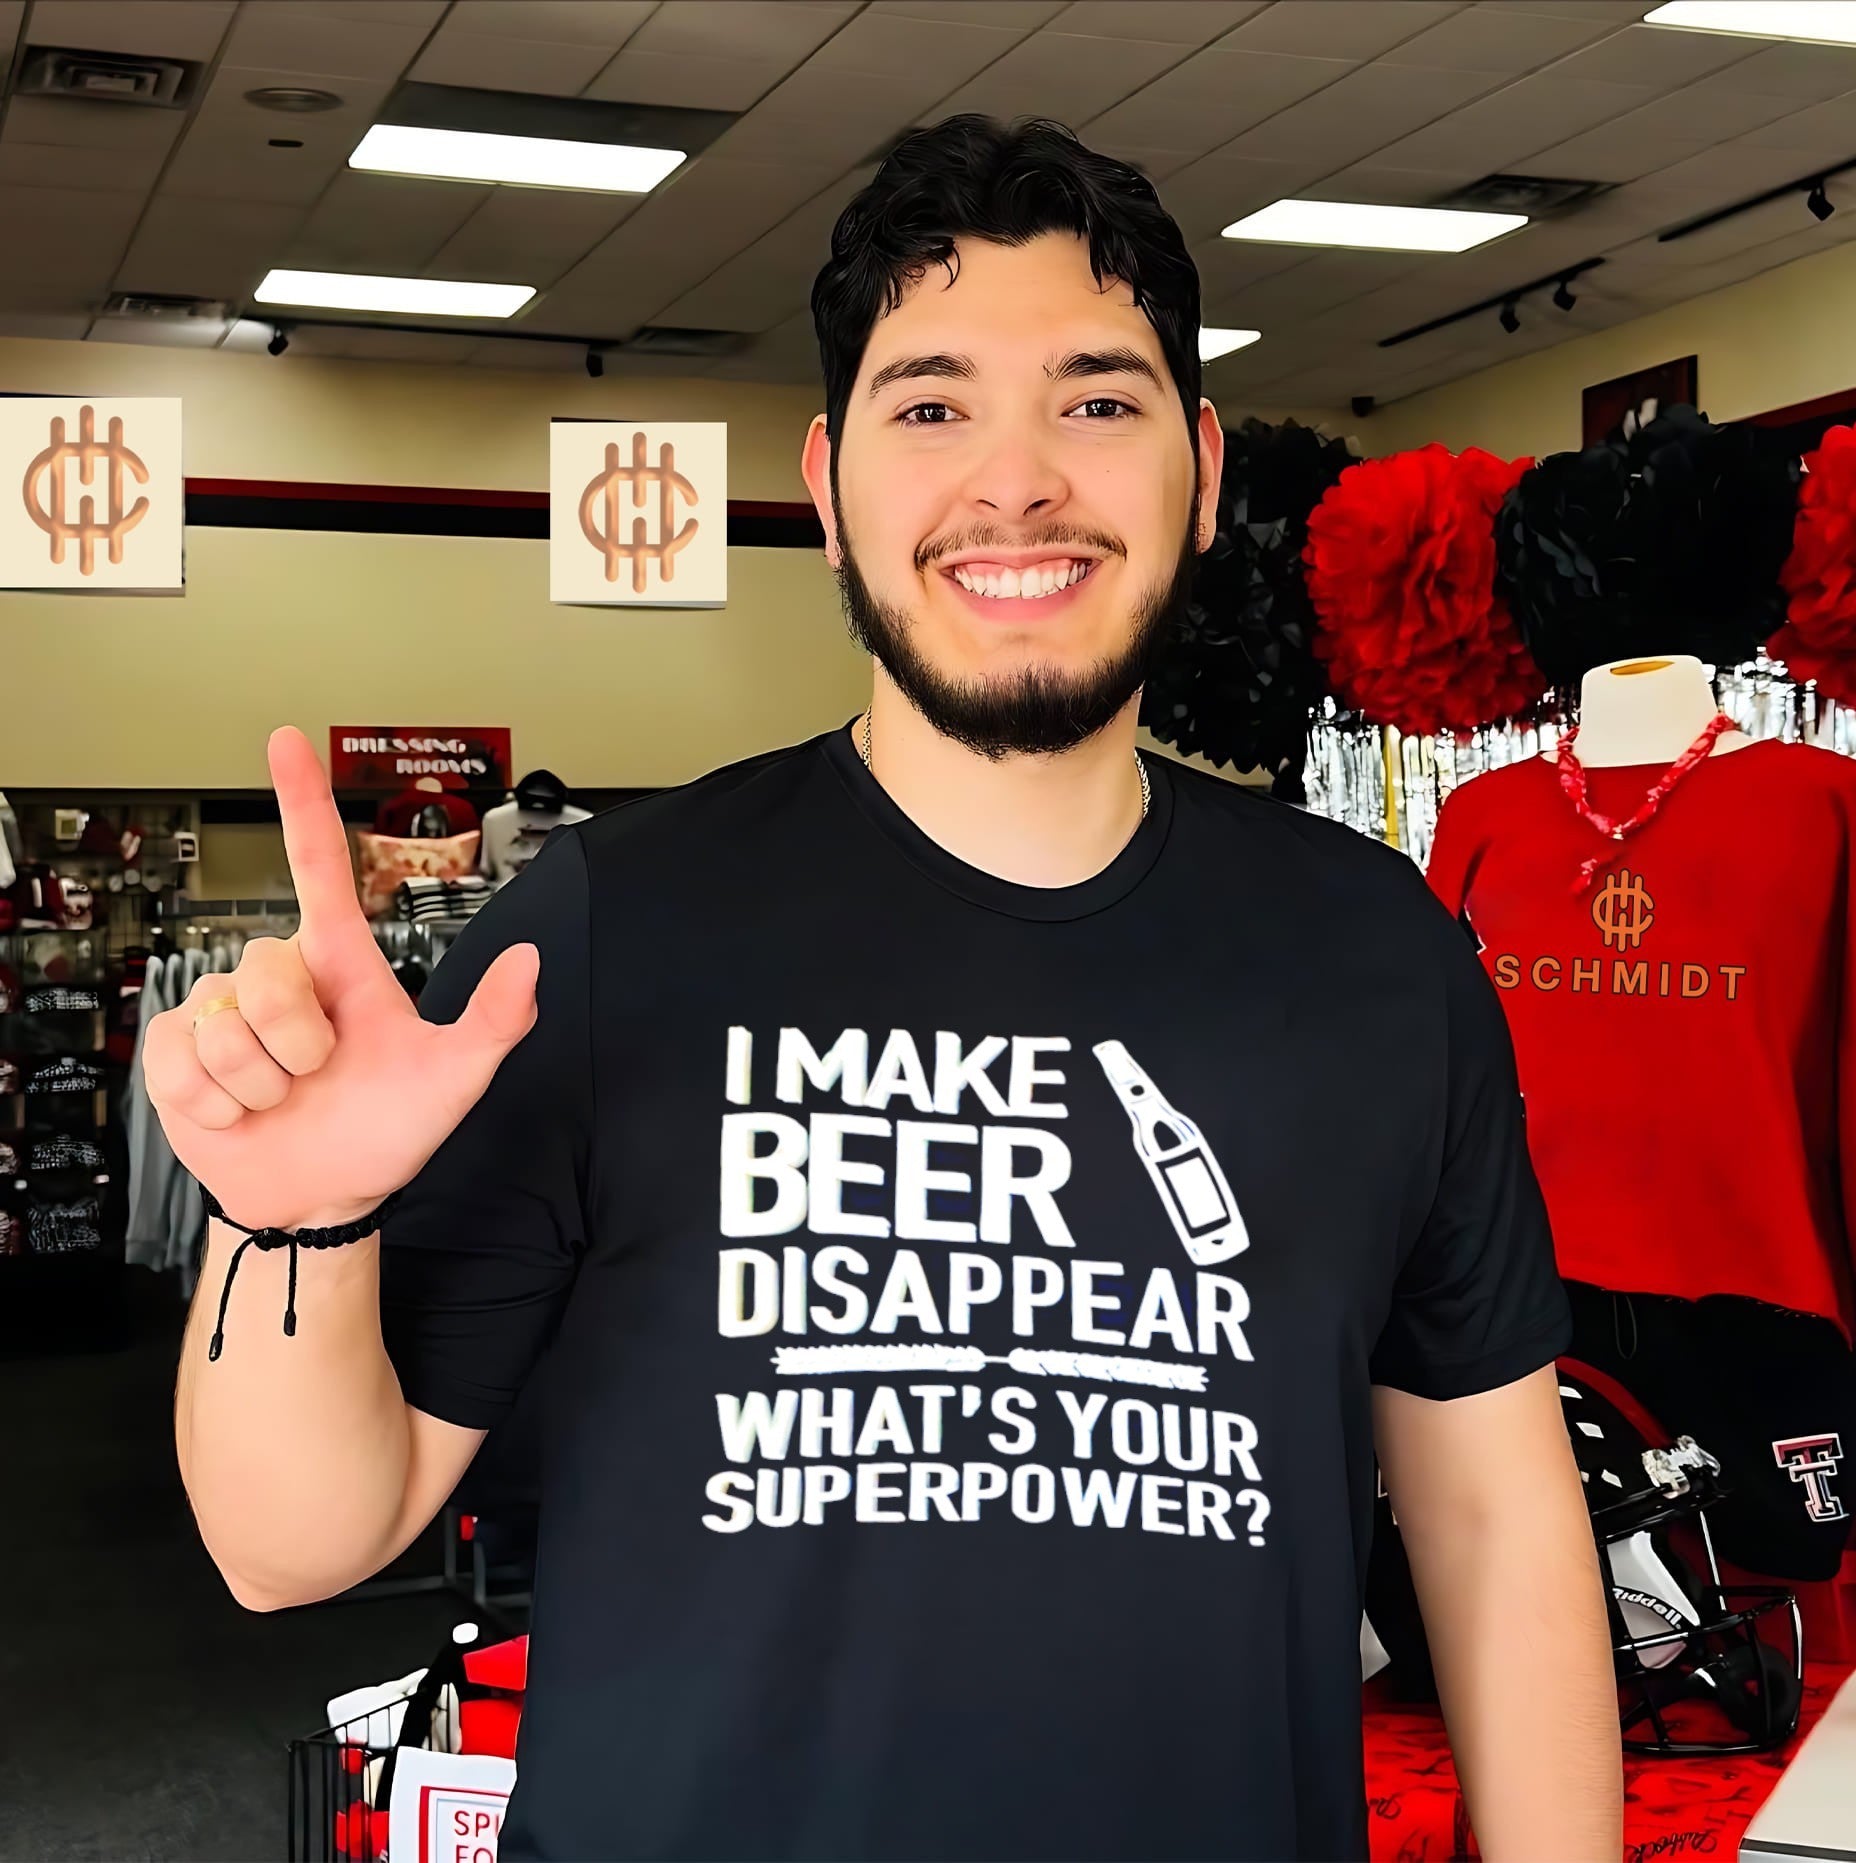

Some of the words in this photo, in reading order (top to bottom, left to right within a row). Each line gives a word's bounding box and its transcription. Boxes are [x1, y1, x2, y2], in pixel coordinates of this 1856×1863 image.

[342, 737, 467, 753] DRESSING
[396, 758, 487, 775] ROOMS
[1494, 954, 1747, 1000] SCHMIDT
[726, 1026, 752, 1104] I
[776, 1028, 1071, 1118] MAKE
[720, 1112, 1076, 1247] BEER
[719, 1246, 1254, 1361] DISAPPEAR
[715, 1385, 1037, 1463] WHAT'S
[1056, 1390, 1262, 1481] YOUR
[702, 1462, 1270, 1546] SUPERPOWER?
